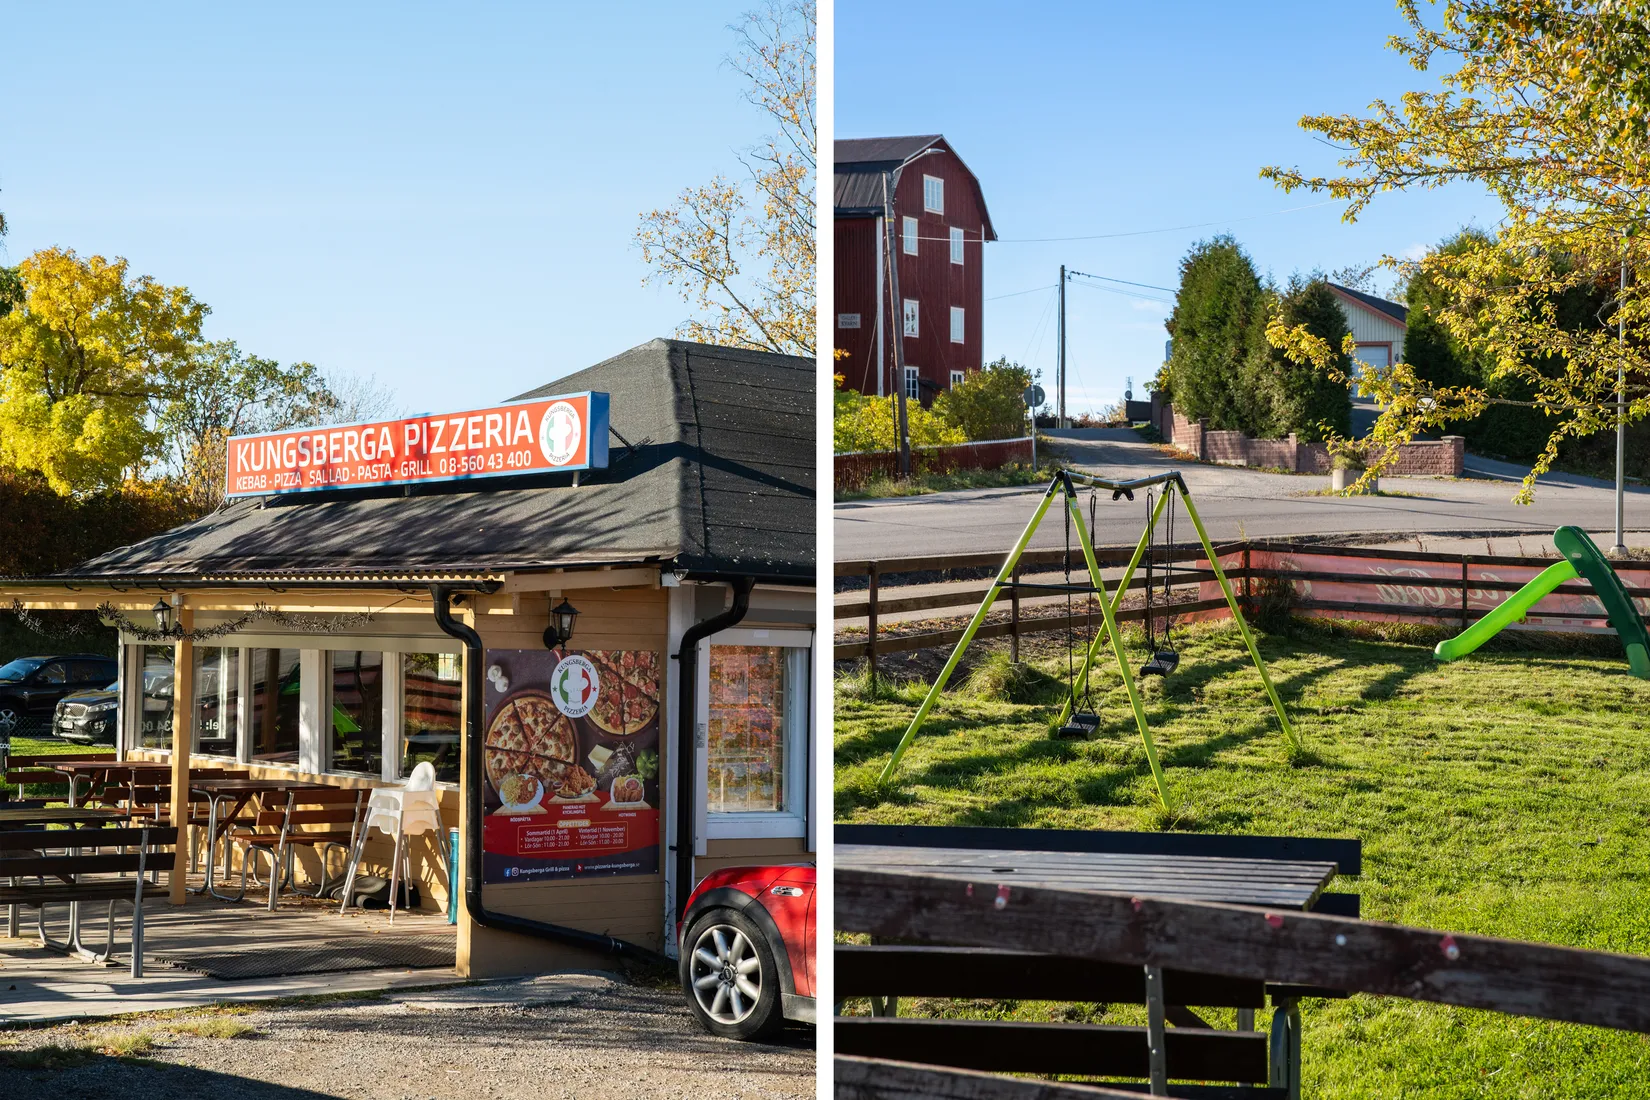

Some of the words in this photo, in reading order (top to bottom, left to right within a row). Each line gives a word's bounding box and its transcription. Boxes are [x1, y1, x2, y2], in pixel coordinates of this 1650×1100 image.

[545, 405, 576, 422] KUNGSBERGA
[237, 426, 395, 473] KUNGSBERGA
[404, 410, 535, 456] PIZZERIA
[549, 453, 570, 463] PIZZERIA
[236, 475, 267, 490] KEBAB
[274, 472, 302, 488] PIZZA
[309, 467, 350, 485] SALLAD
[358, 463, 393, 481] PASTA
[401, 459, 433, 477] GRILL
[487, 452, 503, 469] 43
[506, 450, 532, 467] 400
[557, 658, 592, 674] KUNGSBERGA
[563, 705, 588, 715] PIZZERIA
[520, 867, 544, 875] Kungsberga
